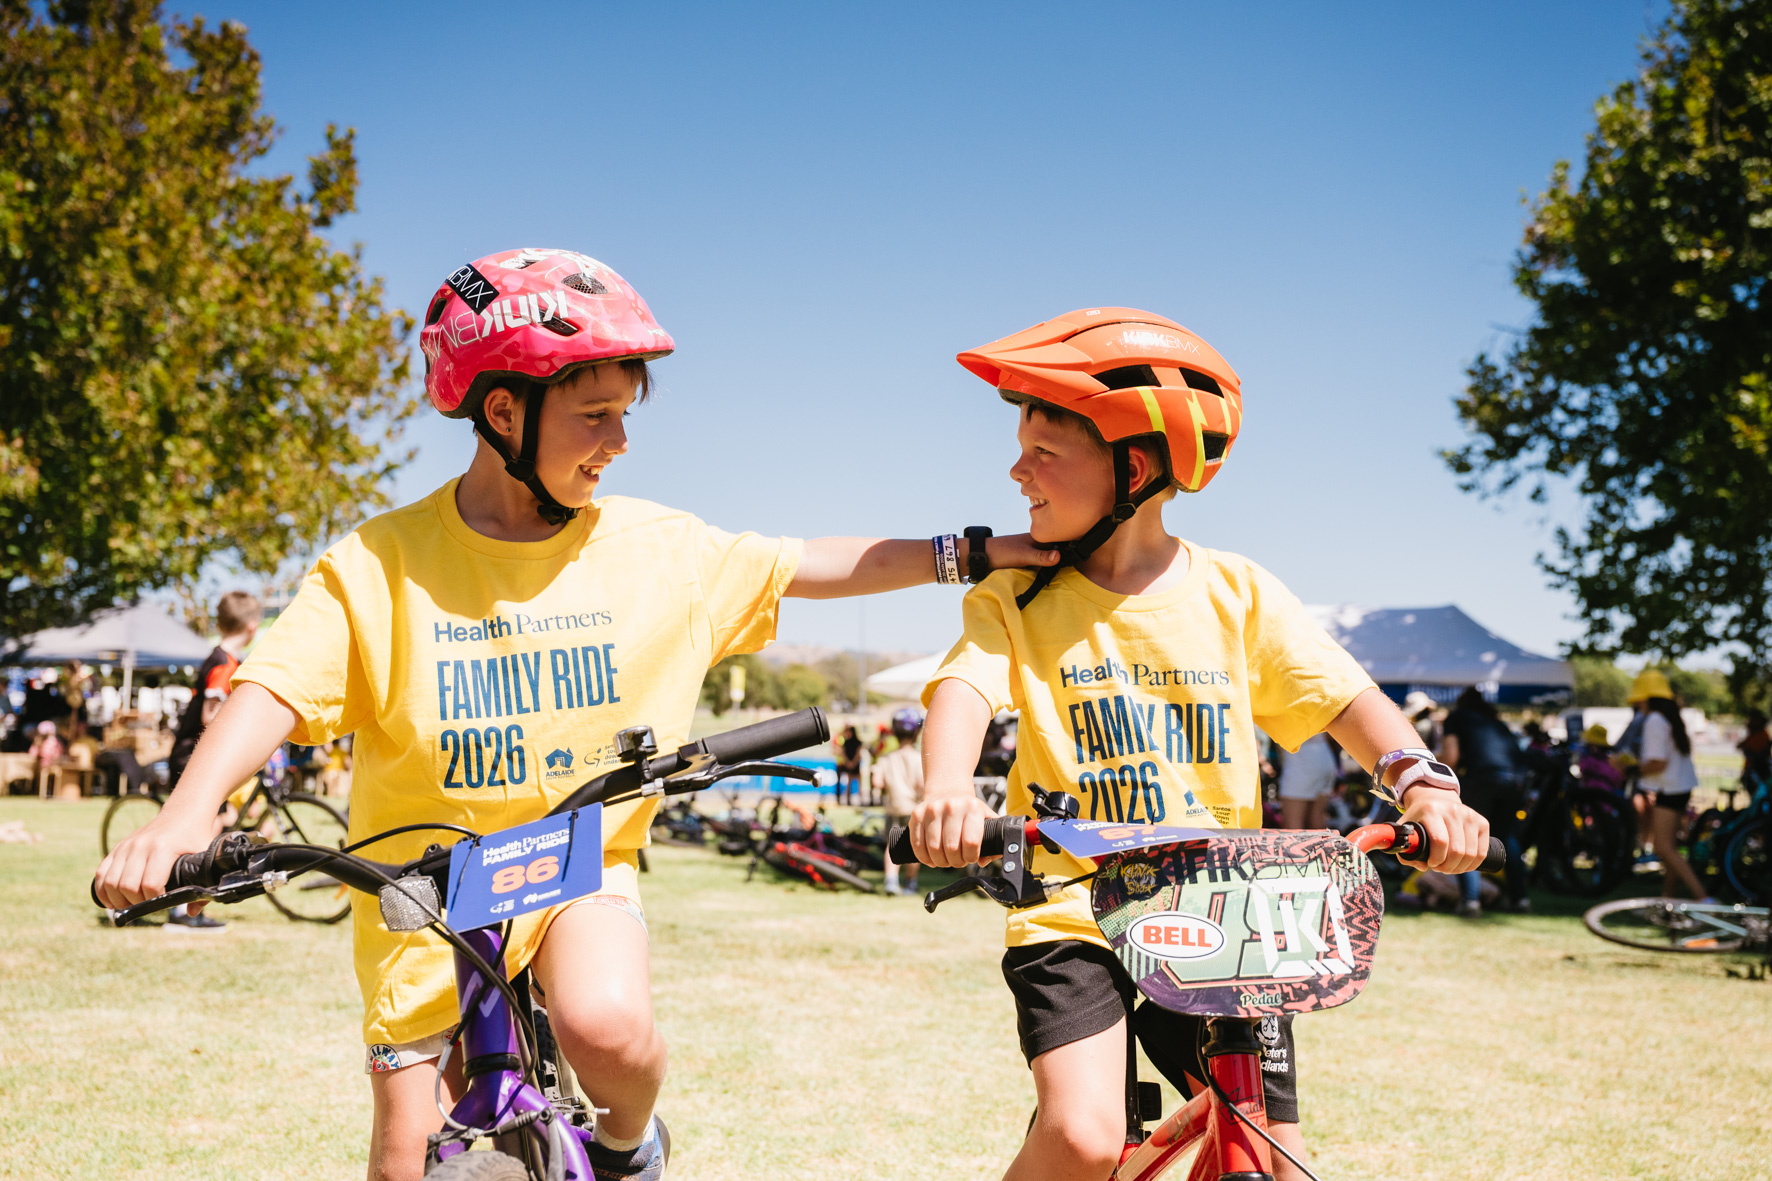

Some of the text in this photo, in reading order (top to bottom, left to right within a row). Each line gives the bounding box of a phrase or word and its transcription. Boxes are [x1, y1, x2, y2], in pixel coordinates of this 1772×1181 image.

[447, 265, 494, 309] BMX
[434, 611, 612, 643] Health Partners
[437, 643, 621, 721] FAMILY RIDE
[1060, 658, 1230, 688] Health Partners
[1164, 703, 1232, 764] RIDE
[441, 724, 527, 789] 2026
[546, 769, 575, 778] ADELAIDE
[1078, 761, 1167, 825] 2026
[1098, 825, 1156, 840] 87
[491, 855, 560, 894] 86
[1143, 925, 1213, 948] BELL
[1241, 993, 1282, 1007] Pedal
[1263, 1046, 1288, 1059] eter's
